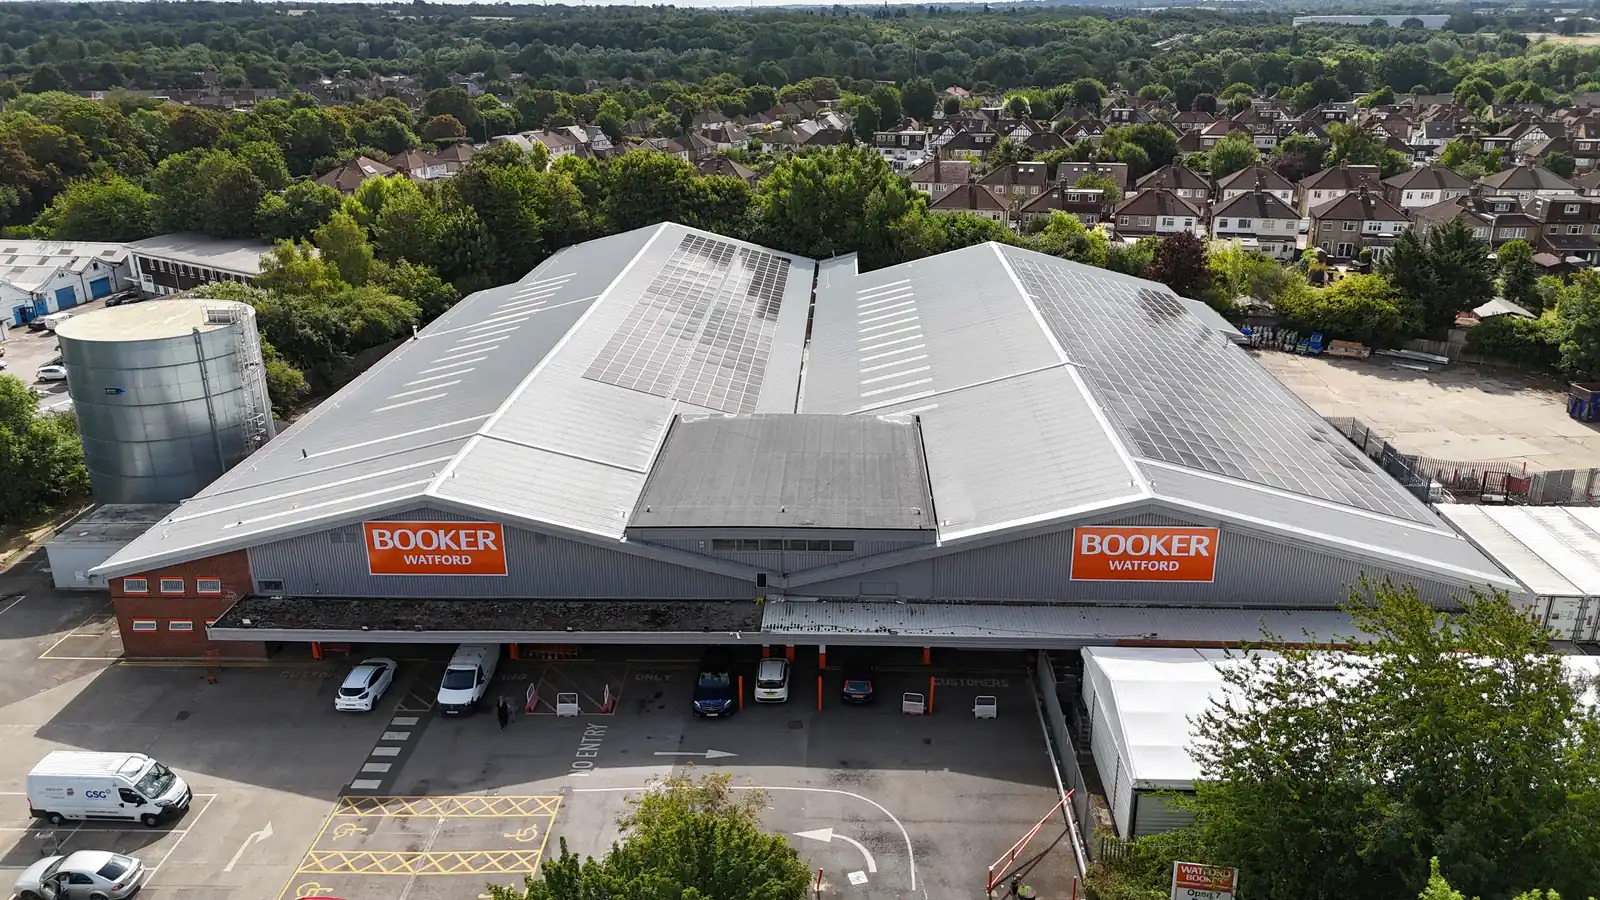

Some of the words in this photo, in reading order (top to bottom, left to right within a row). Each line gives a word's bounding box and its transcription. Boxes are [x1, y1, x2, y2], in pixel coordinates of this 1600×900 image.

[372, 529, 498, 551] BOOKER
[1081, 534, 1210, 557] BOOKER
[403, 554, 472, 565] WATFORD
[1108, 560, 1180, 571] WATFORD
[933, 677, 1009, 687] CUSTOMERS
[575, 722, 608, 757] ENTRY
[567, 761, 594, 777] NO
[85, 790, 107, 799] GSG
[1187, 889, 1213, 898] Open
